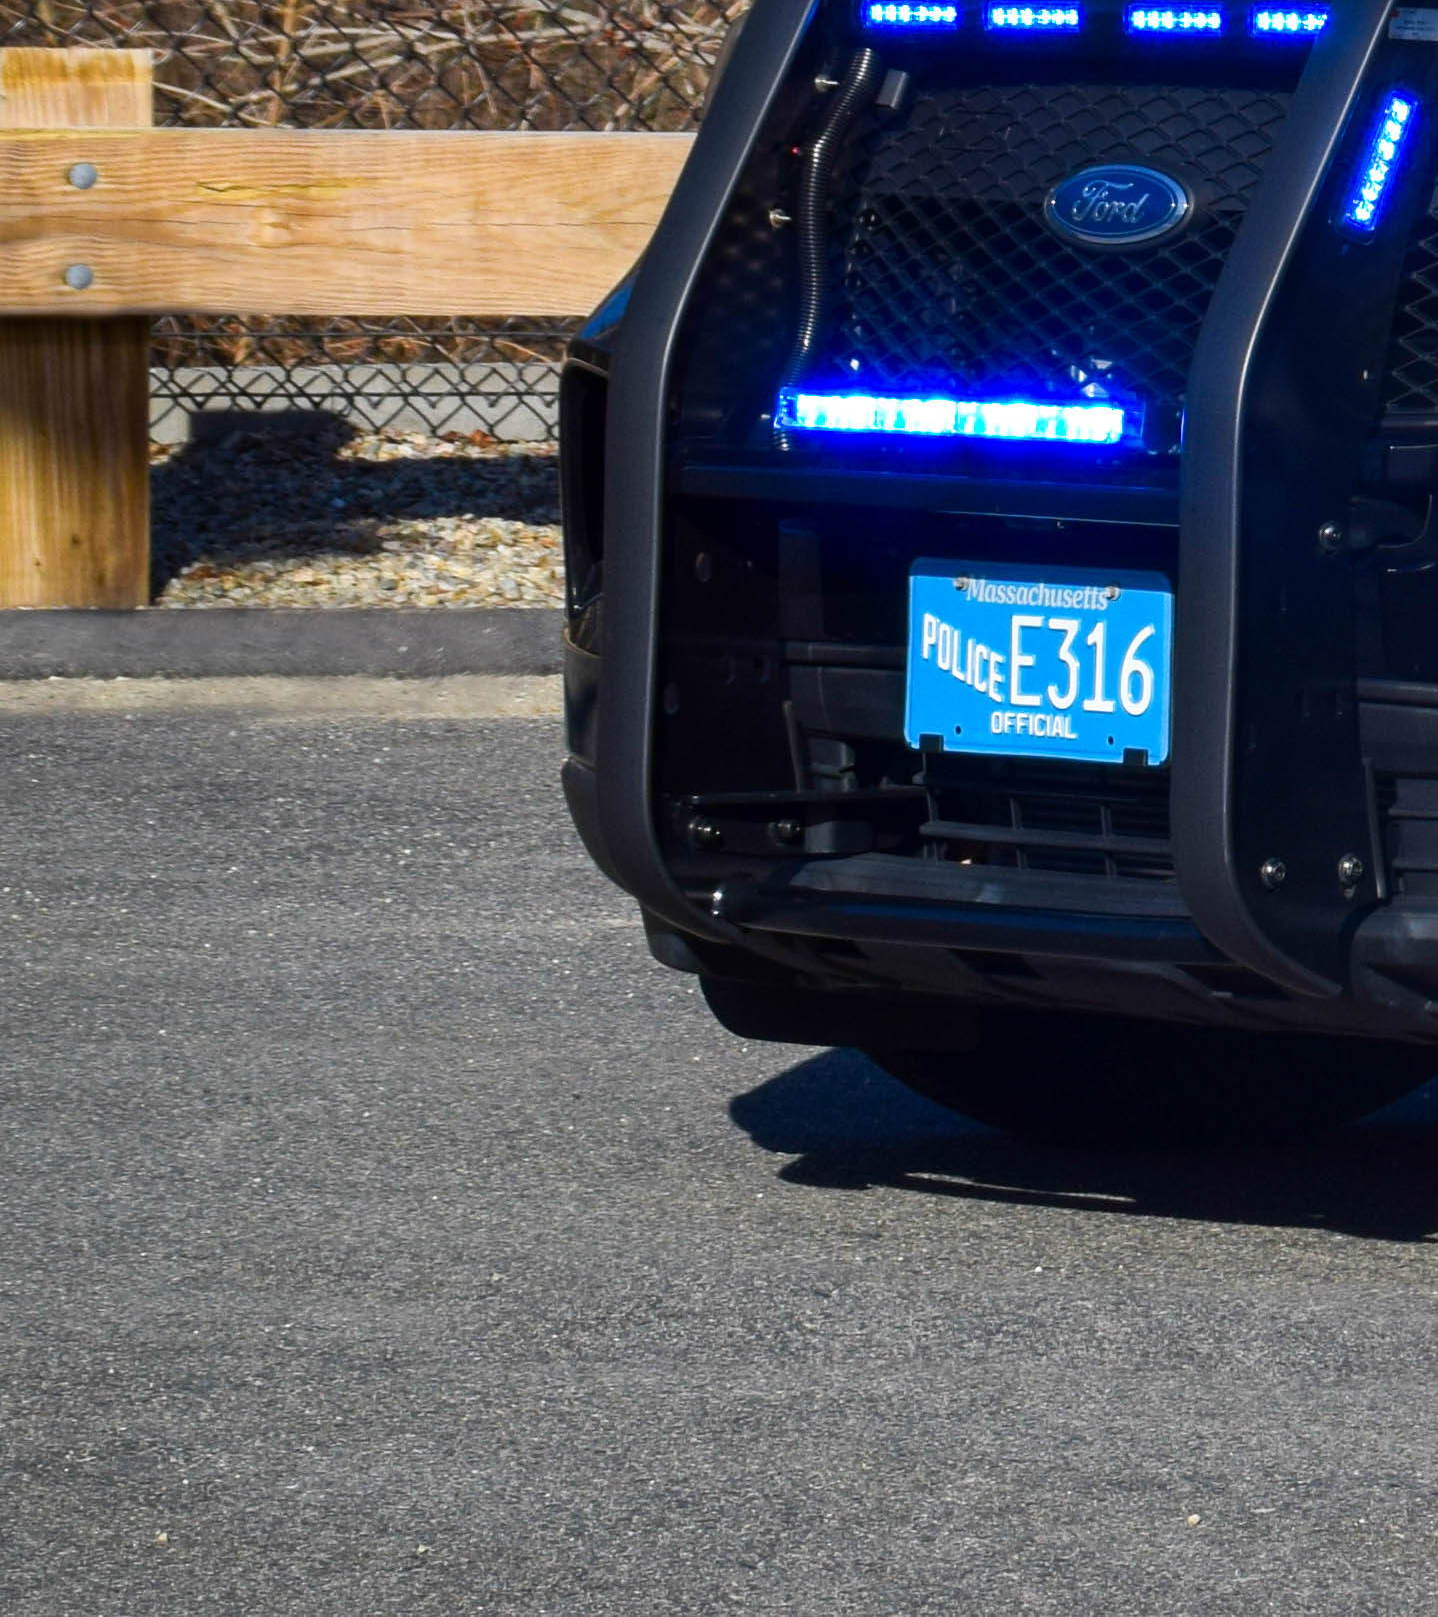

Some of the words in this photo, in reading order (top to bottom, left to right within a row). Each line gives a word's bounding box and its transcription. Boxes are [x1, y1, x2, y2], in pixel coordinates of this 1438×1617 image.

[1072, 179, 1150, 224] Ford
[965, 575, 1109, 611] Massachusetts
[922, 612, 1006, 703] POLICE
[1009, 614, 1156, 717] E316
[990, 711, 1078, 739] OFFICIAL
